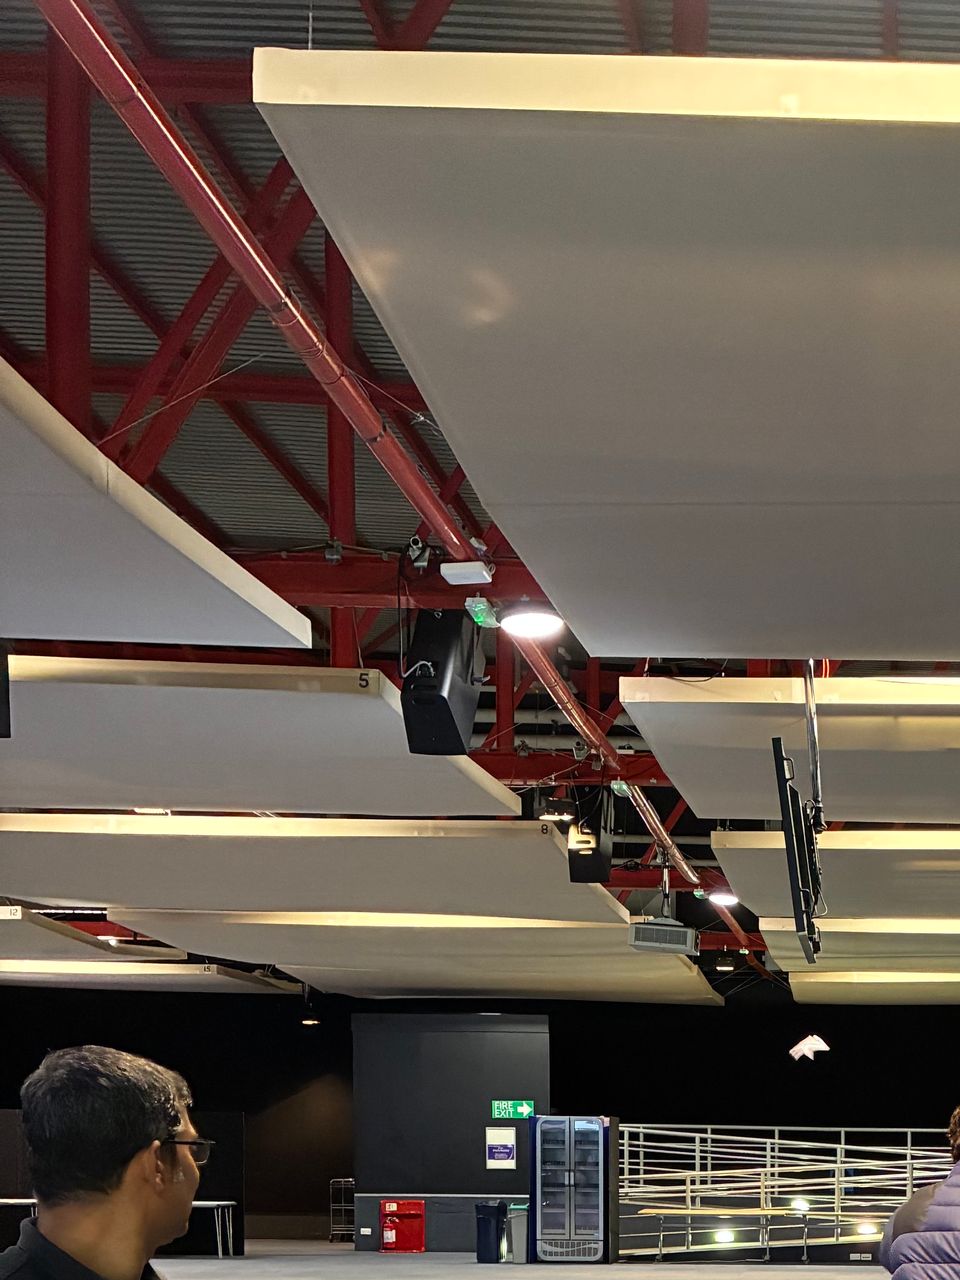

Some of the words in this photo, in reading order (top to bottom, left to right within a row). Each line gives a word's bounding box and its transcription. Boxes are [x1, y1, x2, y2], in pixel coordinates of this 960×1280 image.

[359, 672, 369, 688] 5
[541, 823, 549, 835] 8
[9, 908, 18, 917] 12
[494, 1101, 514, 1110] FIRE
[494, 1109, 515, 1118] EXIT
